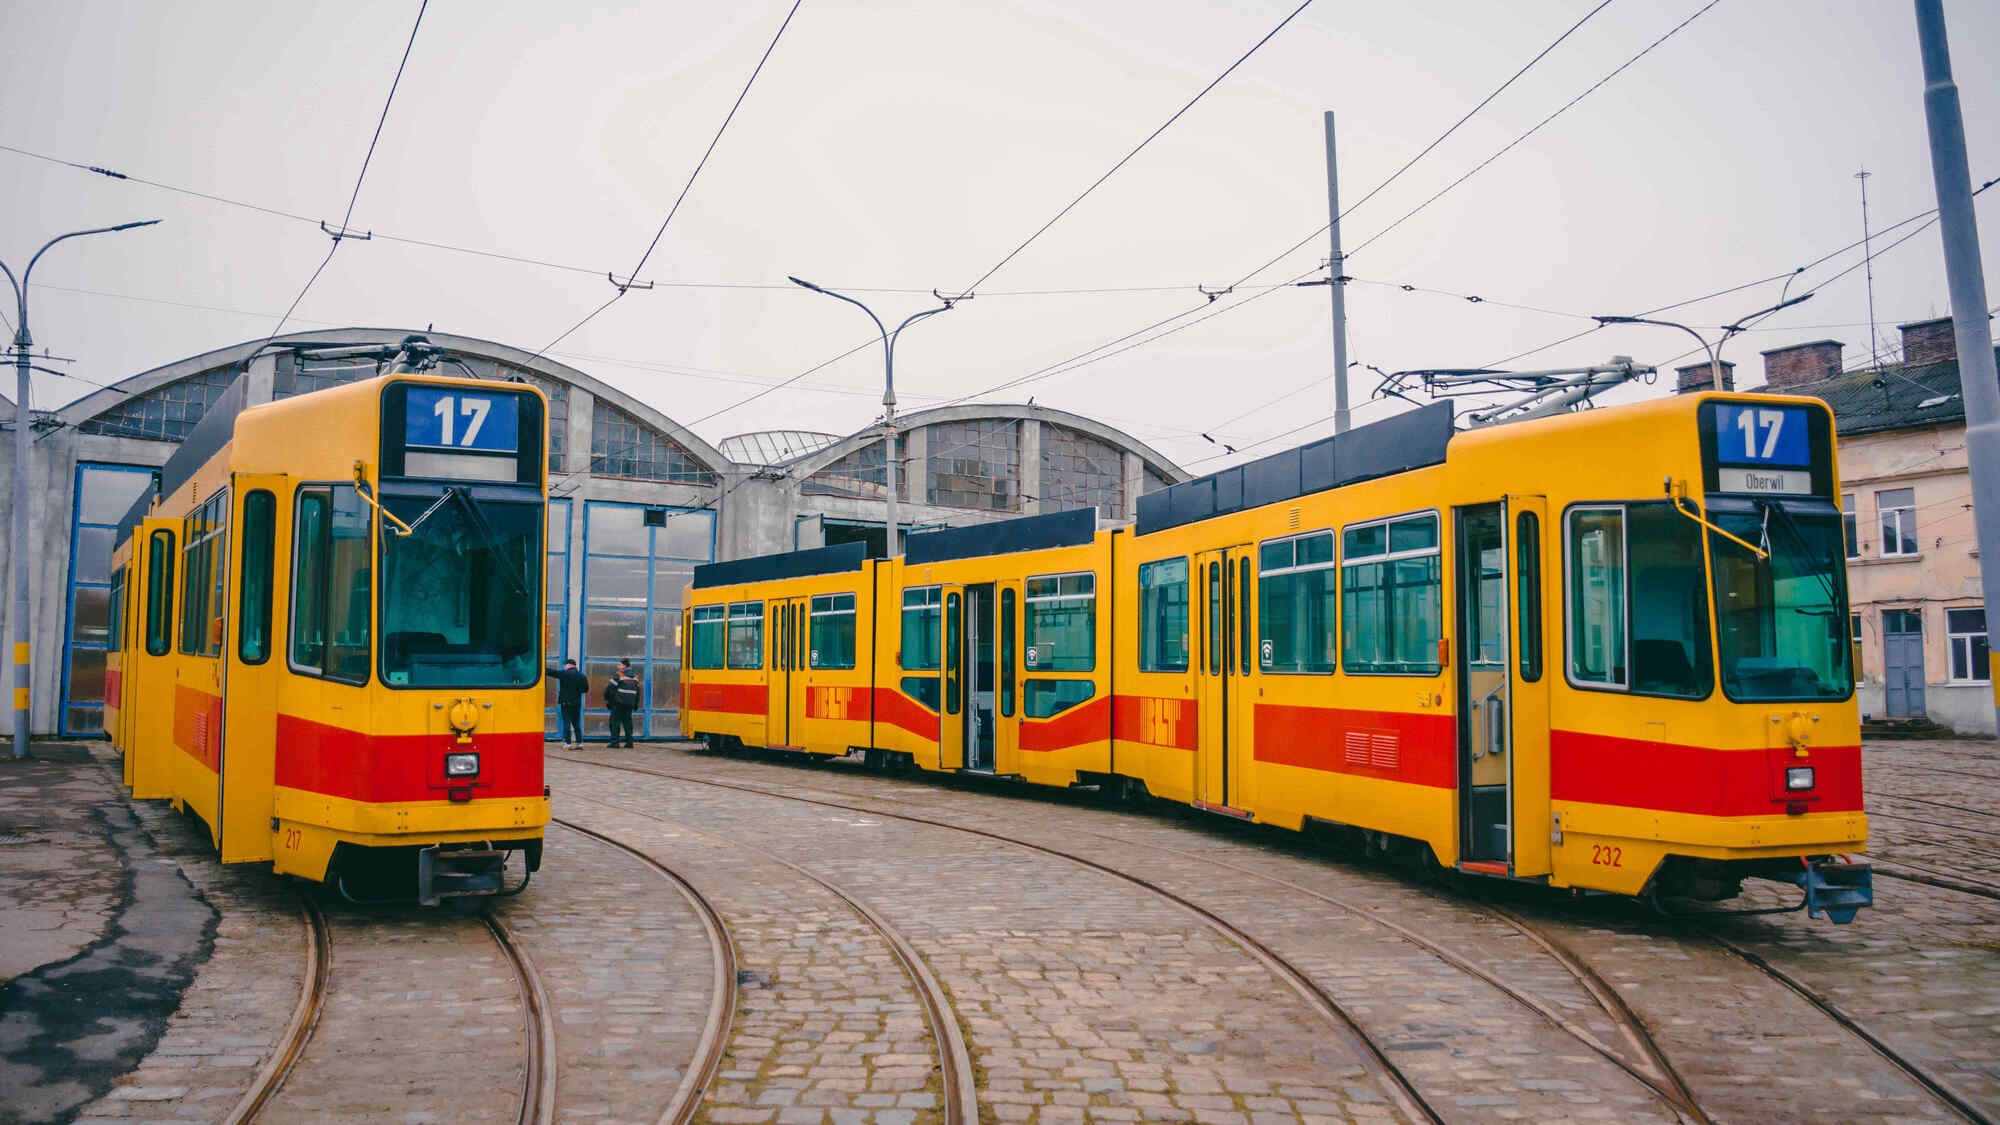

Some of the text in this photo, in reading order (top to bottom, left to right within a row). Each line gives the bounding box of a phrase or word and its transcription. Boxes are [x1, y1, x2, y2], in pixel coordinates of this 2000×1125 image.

[434, 396, 491, 446] 17
[1738, 409, 1784, 458] 17
[1746, 473, 1784, 491] Oberwil
[1592, 844, 1622, 867] 232
